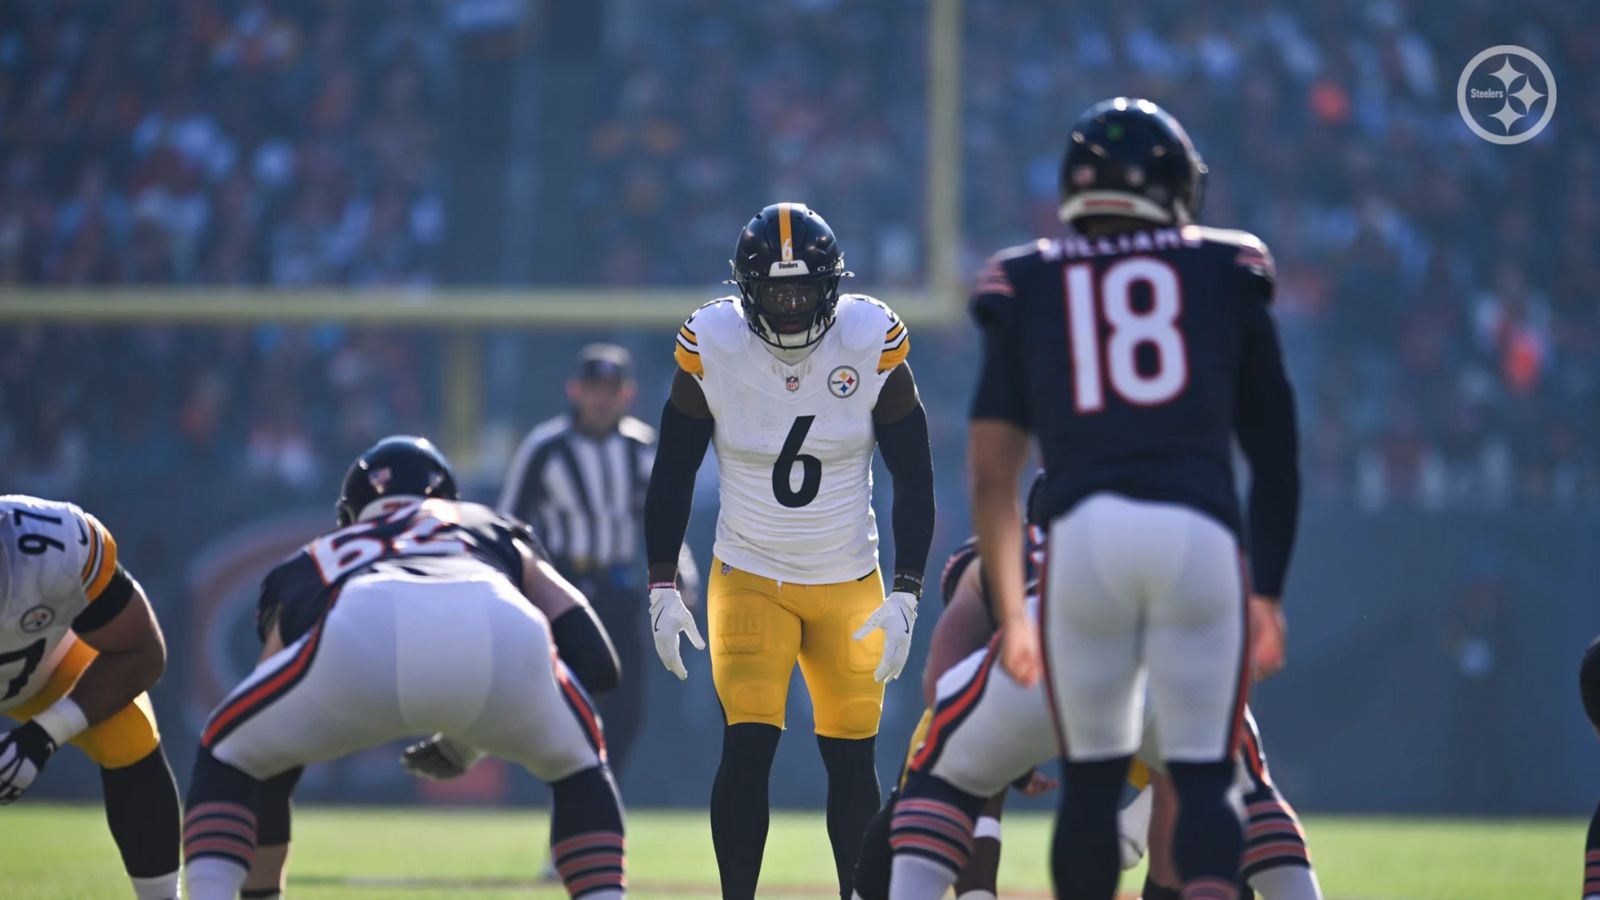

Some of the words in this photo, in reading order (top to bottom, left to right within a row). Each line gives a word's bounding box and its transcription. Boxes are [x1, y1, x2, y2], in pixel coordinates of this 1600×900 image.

[782, 238, 794, 261] 6
[1063, 253, 1188, 416] 18
[771, 414, 822, 508] 6
[14, 508, 65, 556] 97
[311, 499, 469, 586] 62
